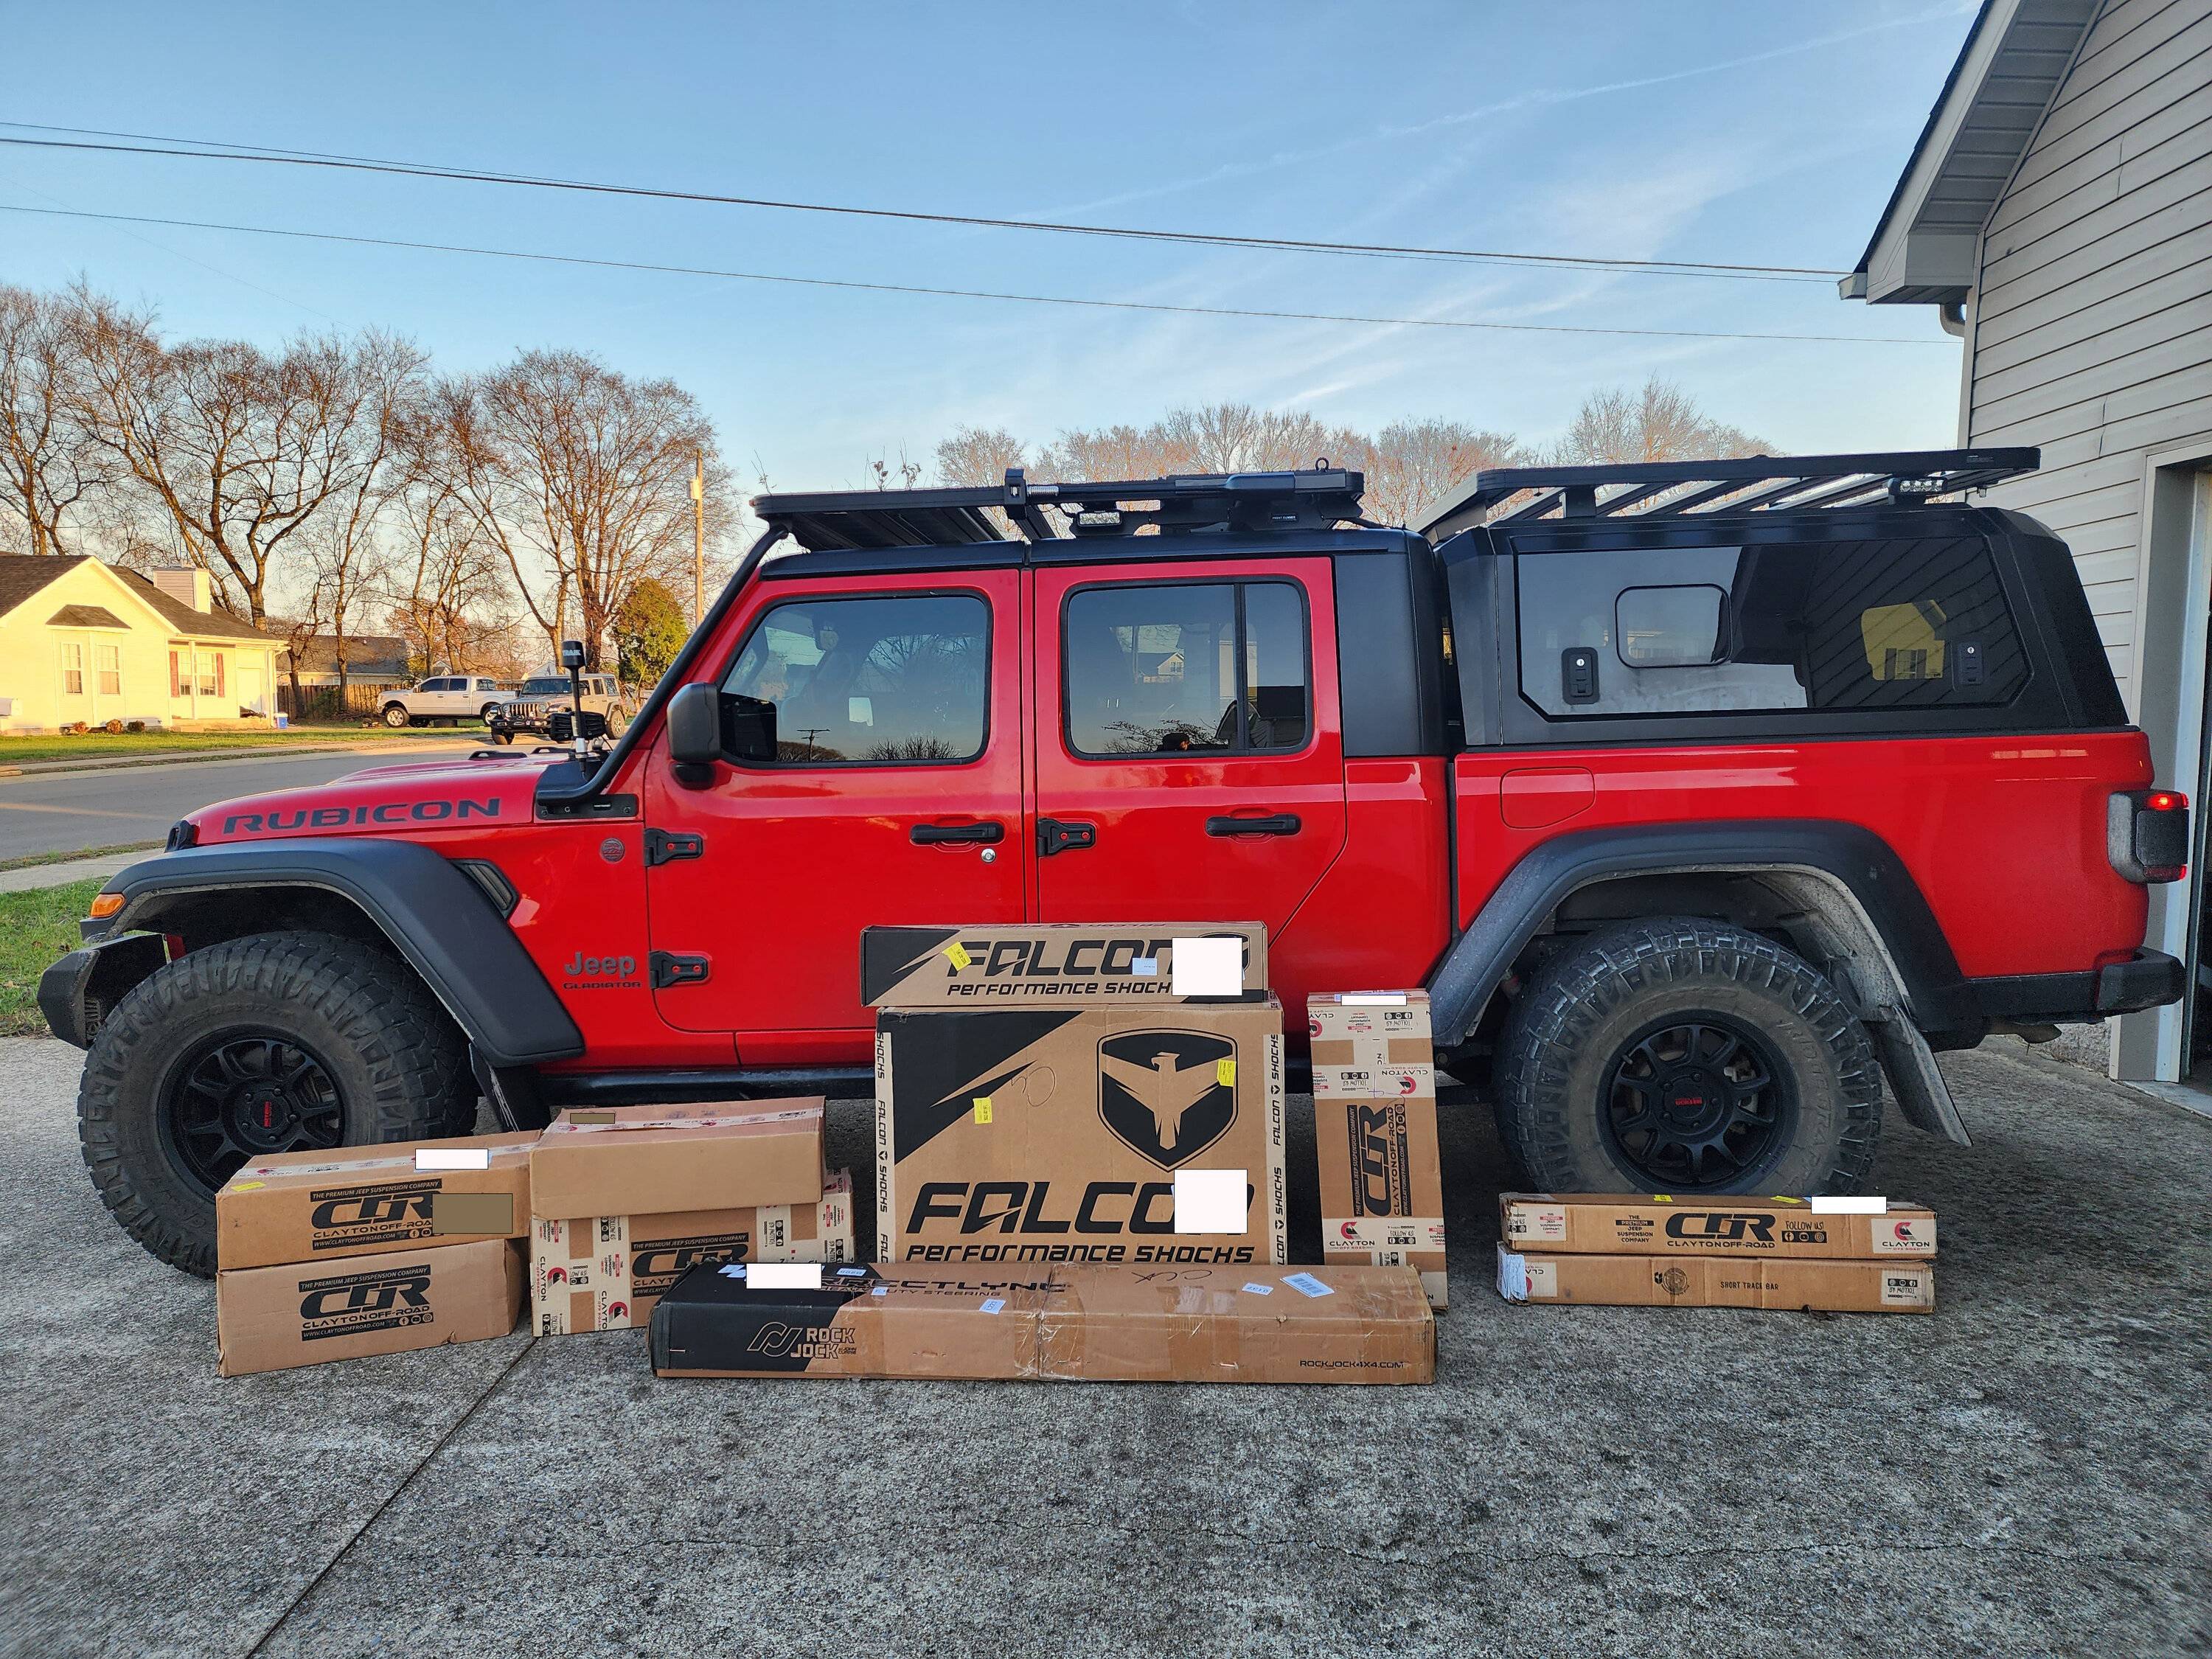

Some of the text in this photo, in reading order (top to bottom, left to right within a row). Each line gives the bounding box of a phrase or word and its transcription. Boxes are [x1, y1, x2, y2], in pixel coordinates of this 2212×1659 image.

[223, 799, 501, 834] RUBICON
[564, 952, 636, 978] Jeep
[1104, 982, 1172, 995] SHOCK
[1273, 1099, 1281, 1146] FALCON
[325, 1189, 355, 1198] PREMIUM
[370, 1184, 408, 1194] SUSPENSION
[408, 1181, 439, 1189] COMPANY
[880, 1165, 888, 1212] SHOCKS
[905, 1181, 1254, 1234] FALCO
[1786, 1220, 1812, 1230] FOLLOW
[313, 1234, 396, 1248] WWW.CLAYTONOFFROAD.COM
[684, 1237, 718, 1245] SUSPENSION
[880, 1234, 888, 1263] FALC
[1134, 1245, 1255, 1263] SHOCKS
[314, 1279, 344, 1288] PREMIUM
[344, 1276, 358, 1284] JEEP
[359, 1273, 397, 1281] SUSPENSION
[397, 1267, 428, 1276] COMPANY
[303, 1322, 385, 1338] WWW.CLAYTONOFFROAD.COM
[806, 1327, 856, 1343] ROCK
[790, 1343, 839, 1359] JOCK
